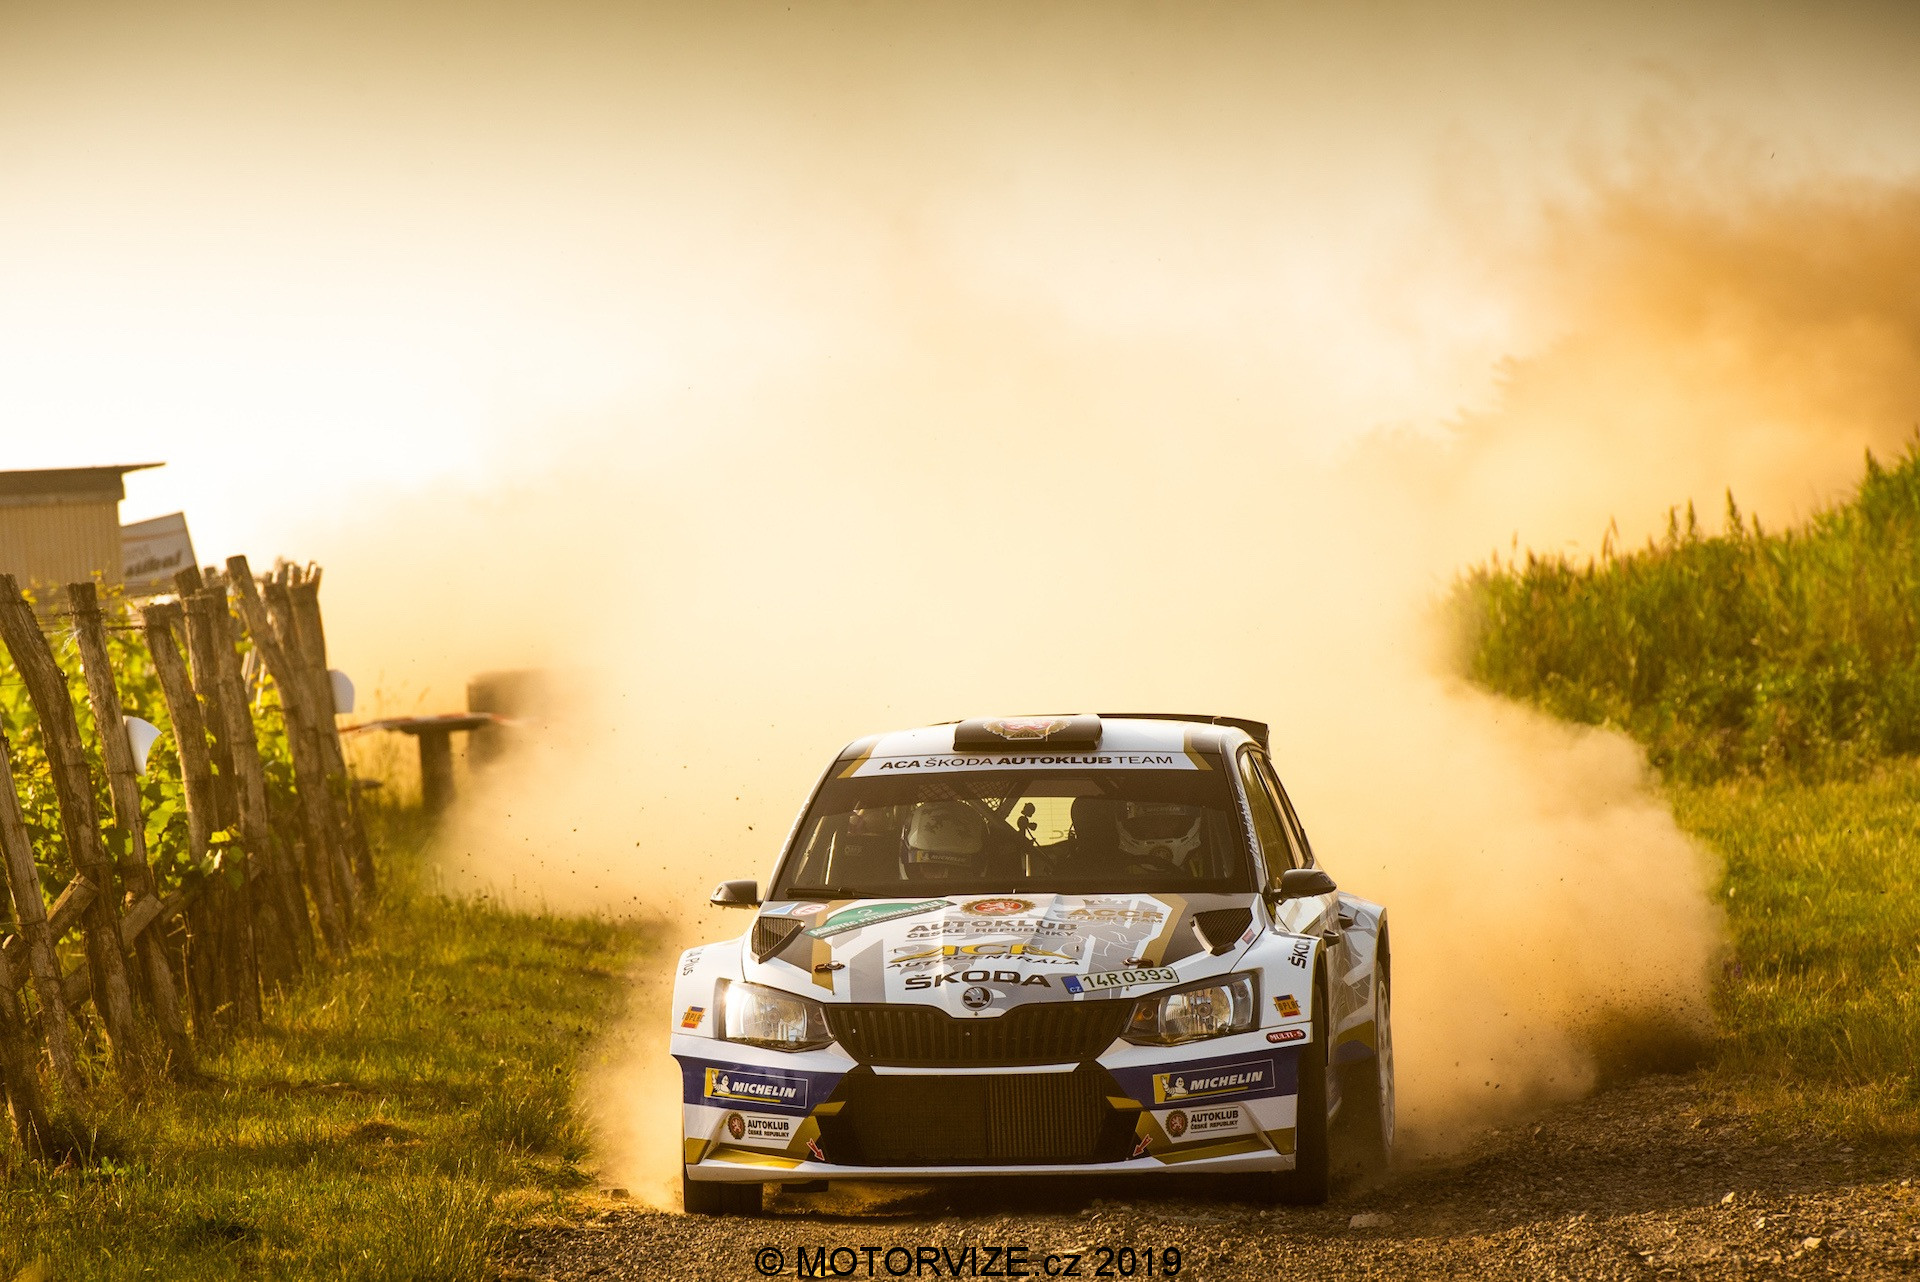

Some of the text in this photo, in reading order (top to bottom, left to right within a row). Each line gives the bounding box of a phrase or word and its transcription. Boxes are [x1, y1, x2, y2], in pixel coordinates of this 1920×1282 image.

[880, 756, 1173, 770] ACA ŠKODA AUTOKLUB TEAM
[1069, 909, 1164, 919] ACCR
[909, 920, 1078, 933] AUTOKLUB
[975, 927, 1076, 937] REPUBLIKY
[1287, 937, 1312, 969] ŠKO
[904, 970, 1052, 990] ŠKODA
[1083, 968, 1174, 988] 14R 0393
[1190, 1071, 1263, 1091] MICHELIN
[732, 1081, 796, 1098] MICHELIN
[1190, 1110, 1239, 1123] AUTOKLUB
[748, 1119, 789, 1131] AUTOKLUB
[1209, 1119, 1239, 1128] REPUBLIKY
[764, 1130, 789, 1138] REPUBLIKY
